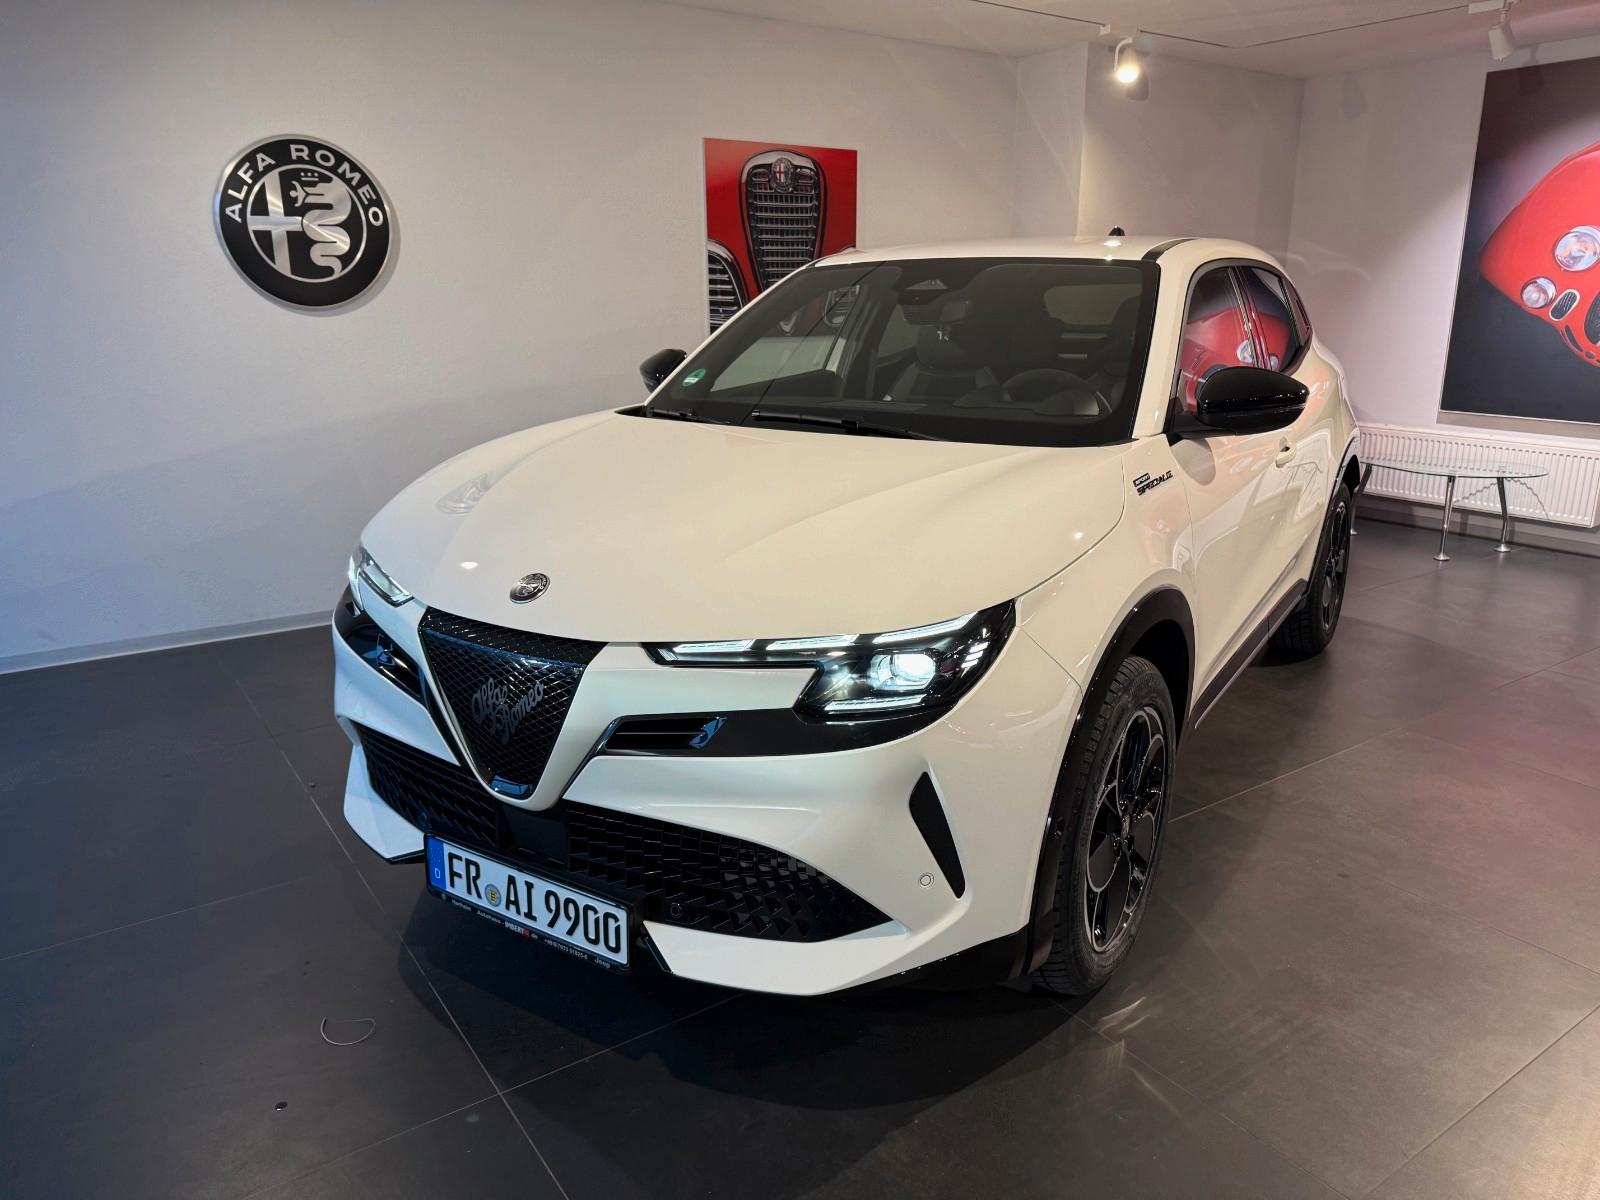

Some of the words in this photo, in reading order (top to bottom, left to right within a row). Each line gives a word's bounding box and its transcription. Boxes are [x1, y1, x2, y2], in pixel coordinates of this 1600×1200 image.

[225, 152, 276, 223] ALFA
[289, 143, 384, 227] ROMEO
[471, 678, 508, 723] Alfa
[491, 680, 544, 745] Romeo
[434, 867, 441, 879] D
[447, 851, 483, 900] FR
[505, 873, 538, 922] AI
[544, 889, 622, 954] 9900
